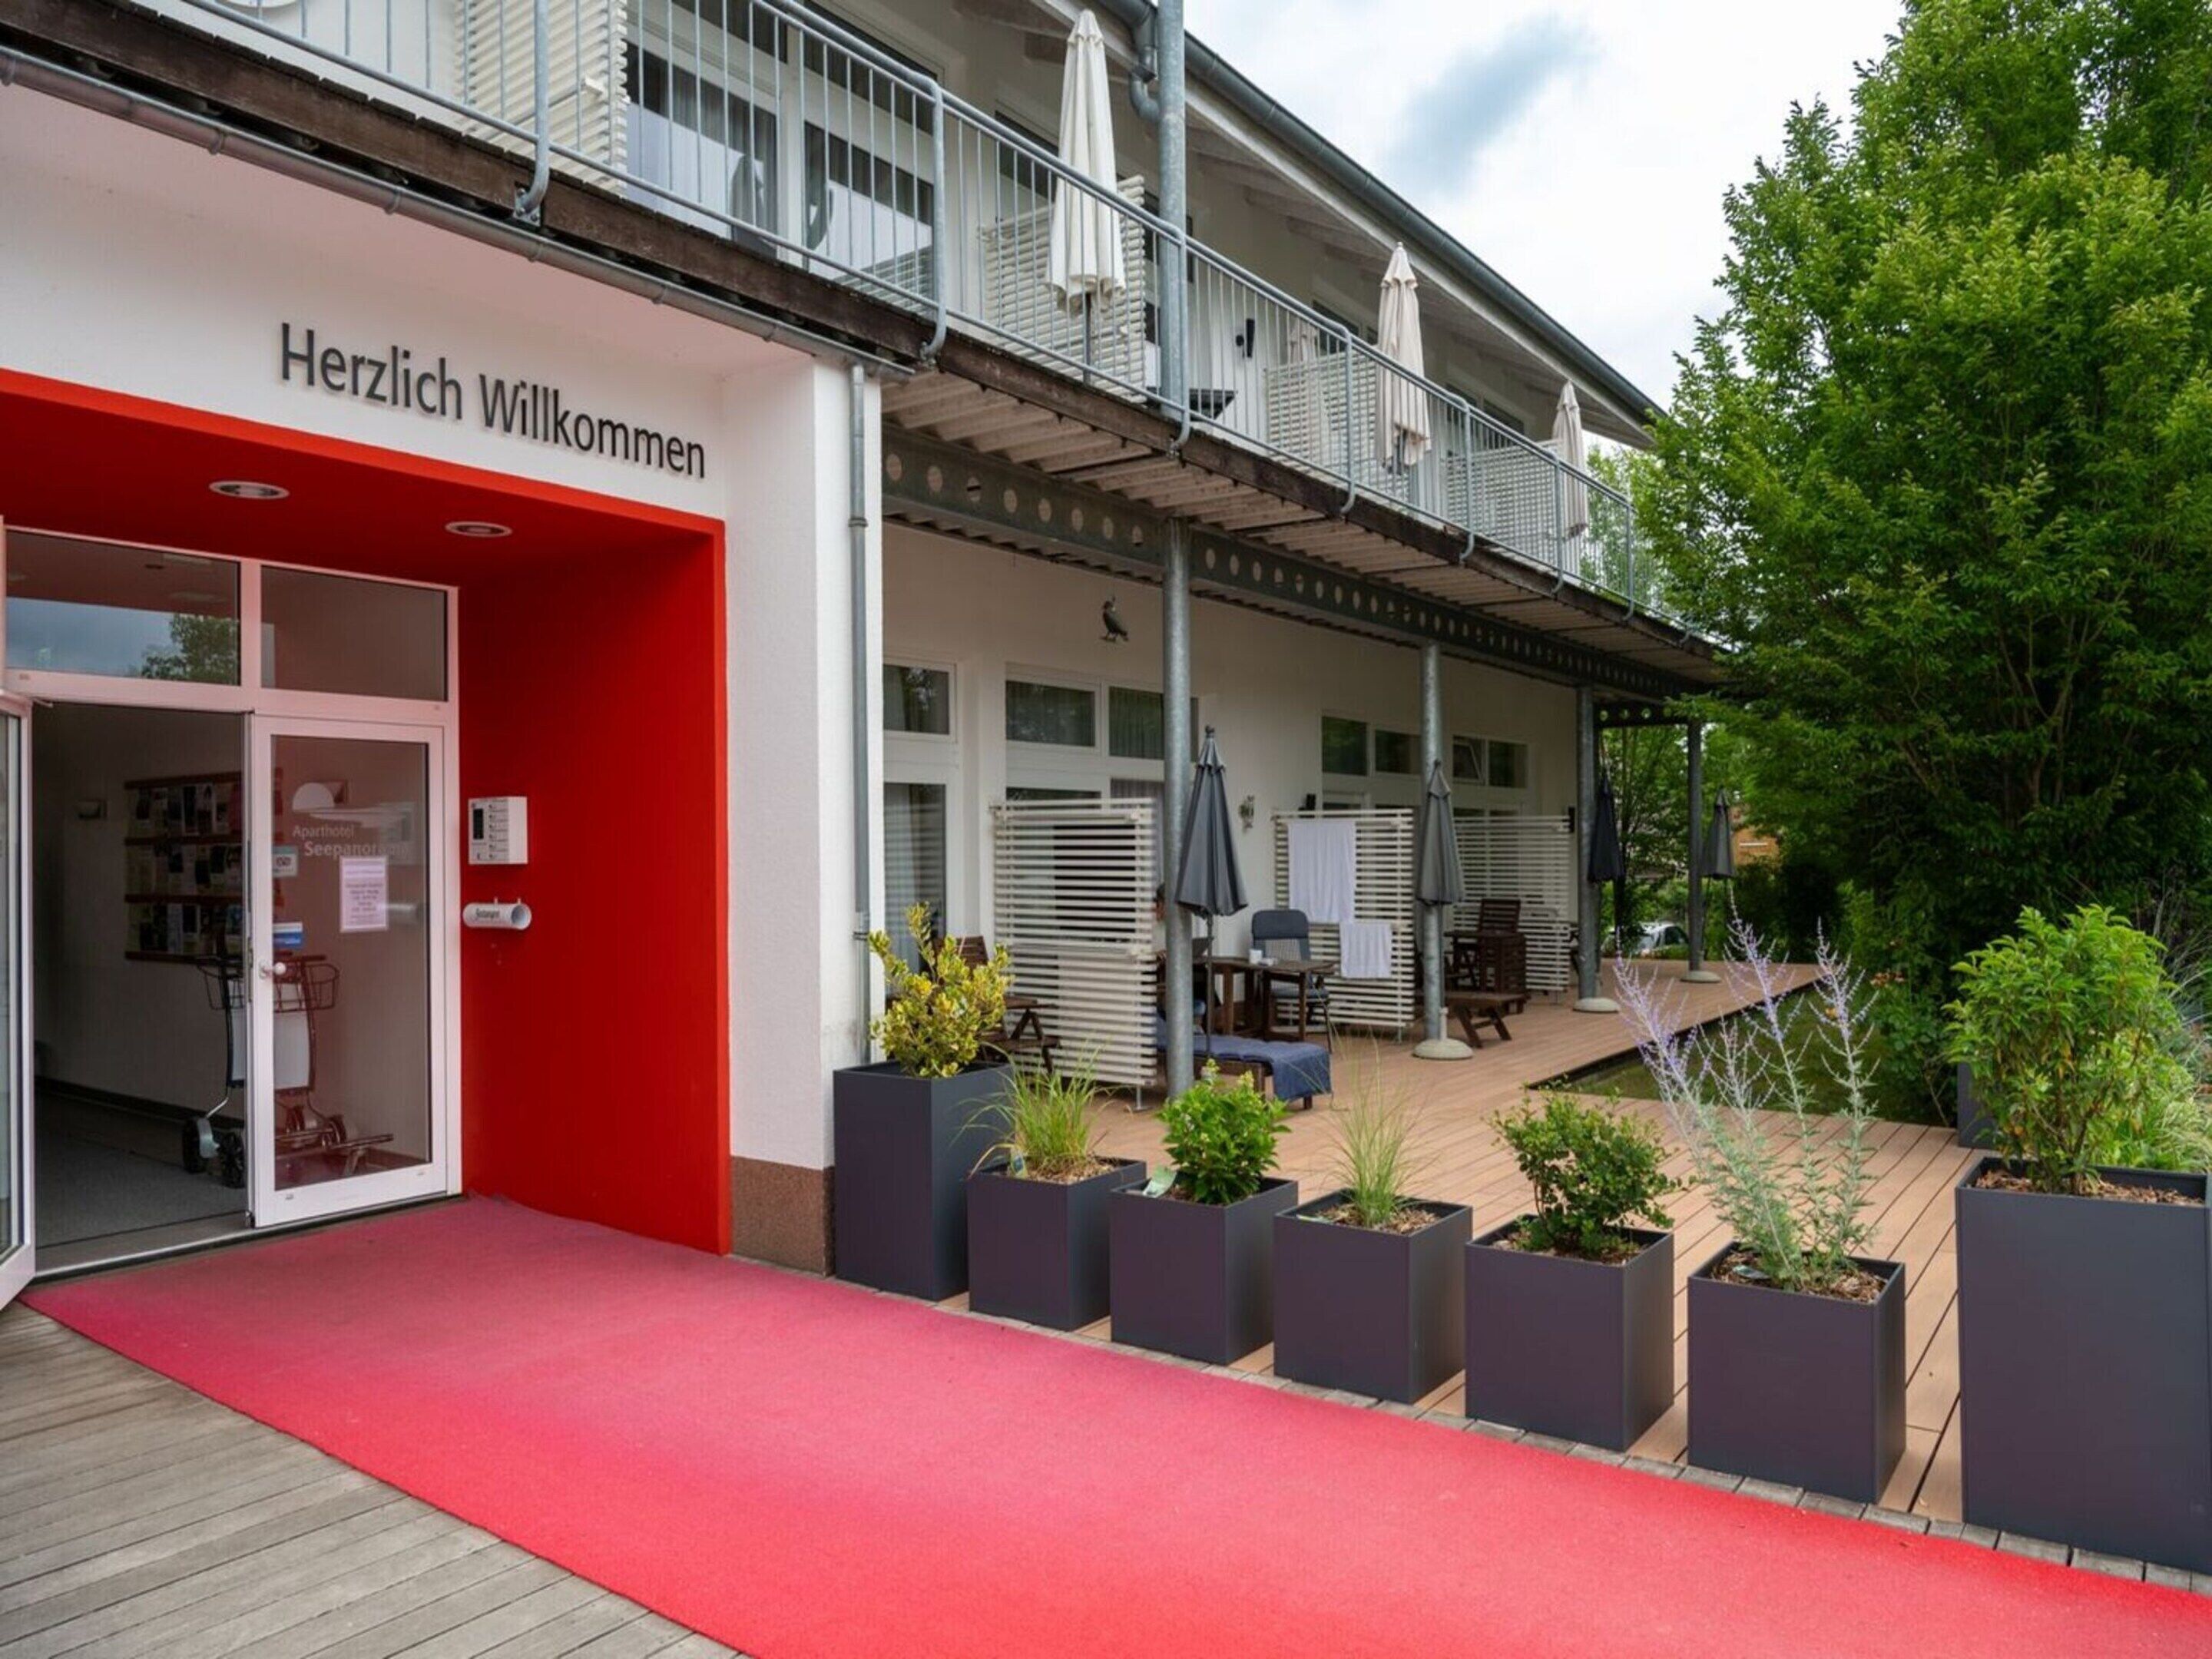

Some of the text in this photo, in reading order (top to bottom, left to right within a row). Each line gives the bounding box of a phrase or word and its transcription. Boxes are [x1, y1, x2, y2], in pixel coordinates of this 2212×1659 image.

[281, 323, 705, 478] Herzlich Willkommen
[293, 825, 355, 841] Aparthotel
[304, 843, 409, 859] Seepanor
